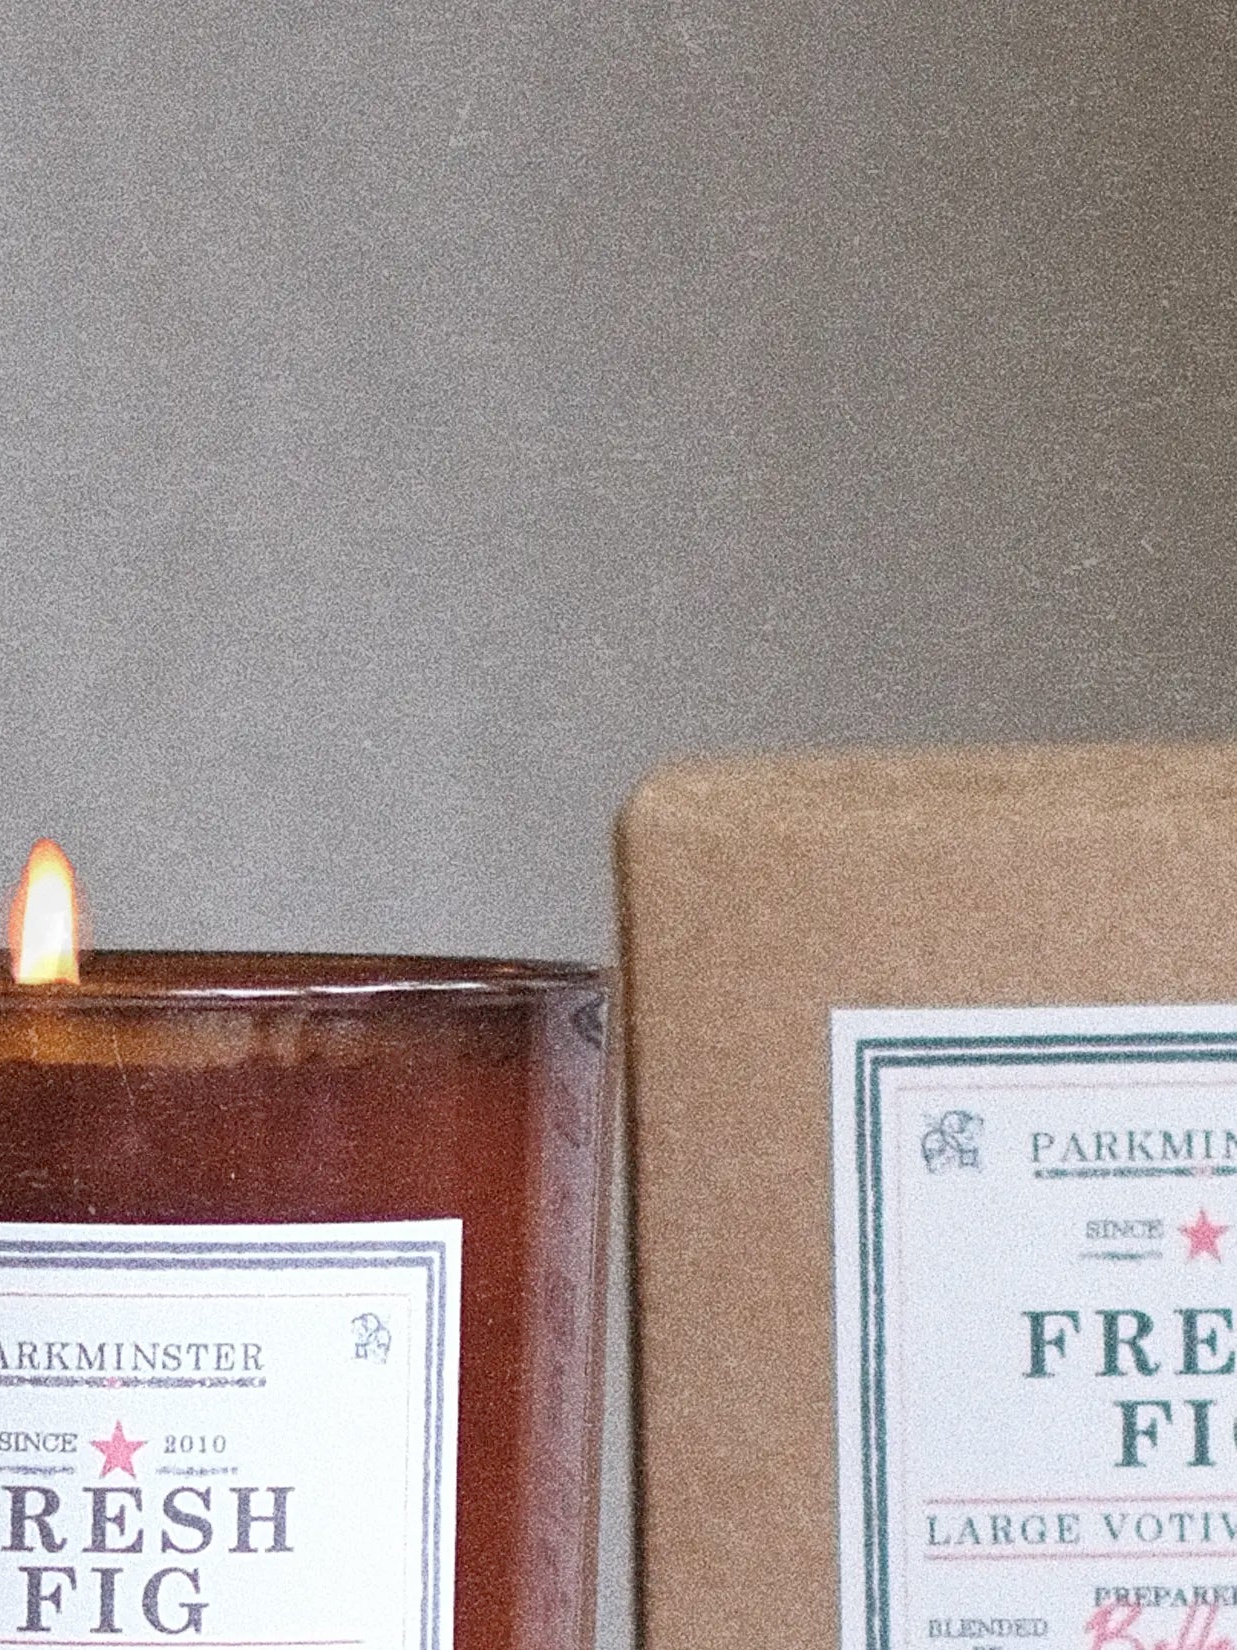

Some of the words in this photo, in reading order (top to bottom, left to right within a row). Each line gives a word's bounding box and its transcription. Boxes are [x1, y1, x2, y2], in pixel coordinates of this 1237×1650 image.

[1085, 1218, 1163, 1241] SINCE
[163, 1434, 227, 1455] 2010
[1113, 1399, 1237, 1468] FI
[926, 1513, 1080, 1547] LARGE
[16, 1565, 209, 1635] FIG
[928, 1617, 1049, 1639] BLENDED
